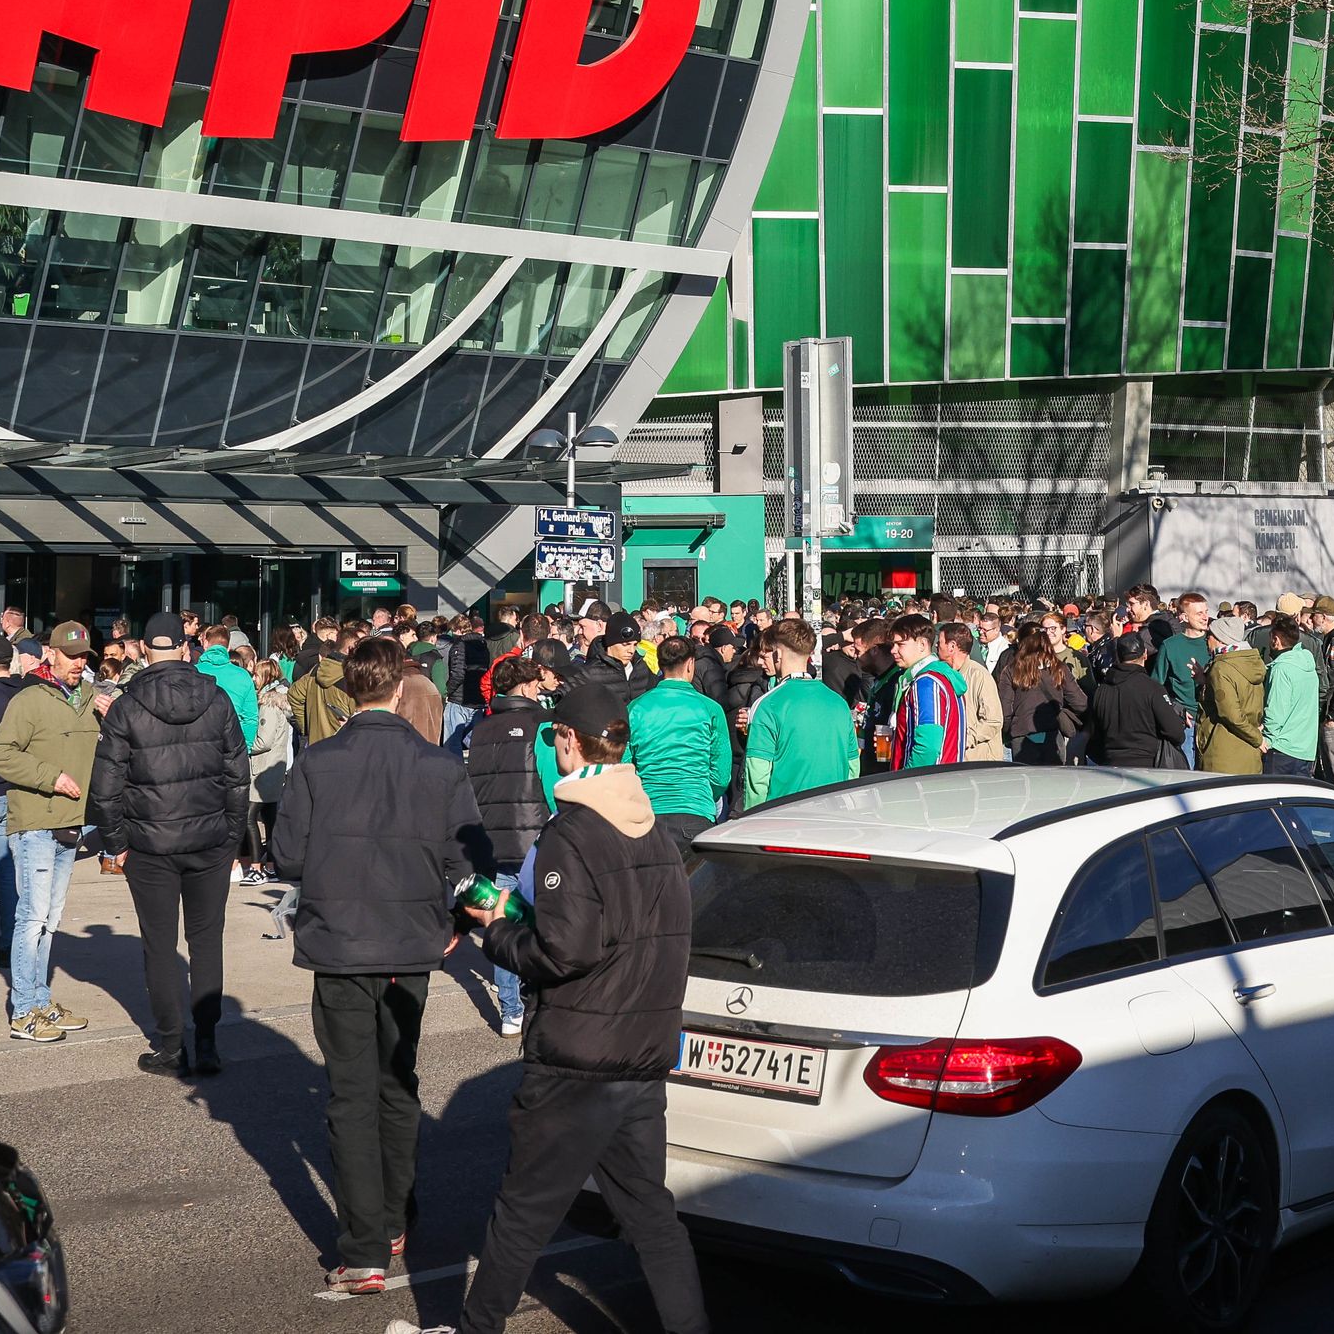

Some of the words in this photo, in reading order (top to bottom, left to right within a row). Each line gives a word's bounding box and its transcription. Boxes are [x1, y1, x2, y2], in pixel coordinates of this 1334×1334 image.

[1254, 509, 1308, 526] GEMEINSAM.
[568, 525, 586, 536] Platz
[885, 529, 914, 538] 19-20
[699, 546, 706, 561] 4
[688, 1038, 706, 1069] W
[721, 1043, 814, 1085] 52741E
